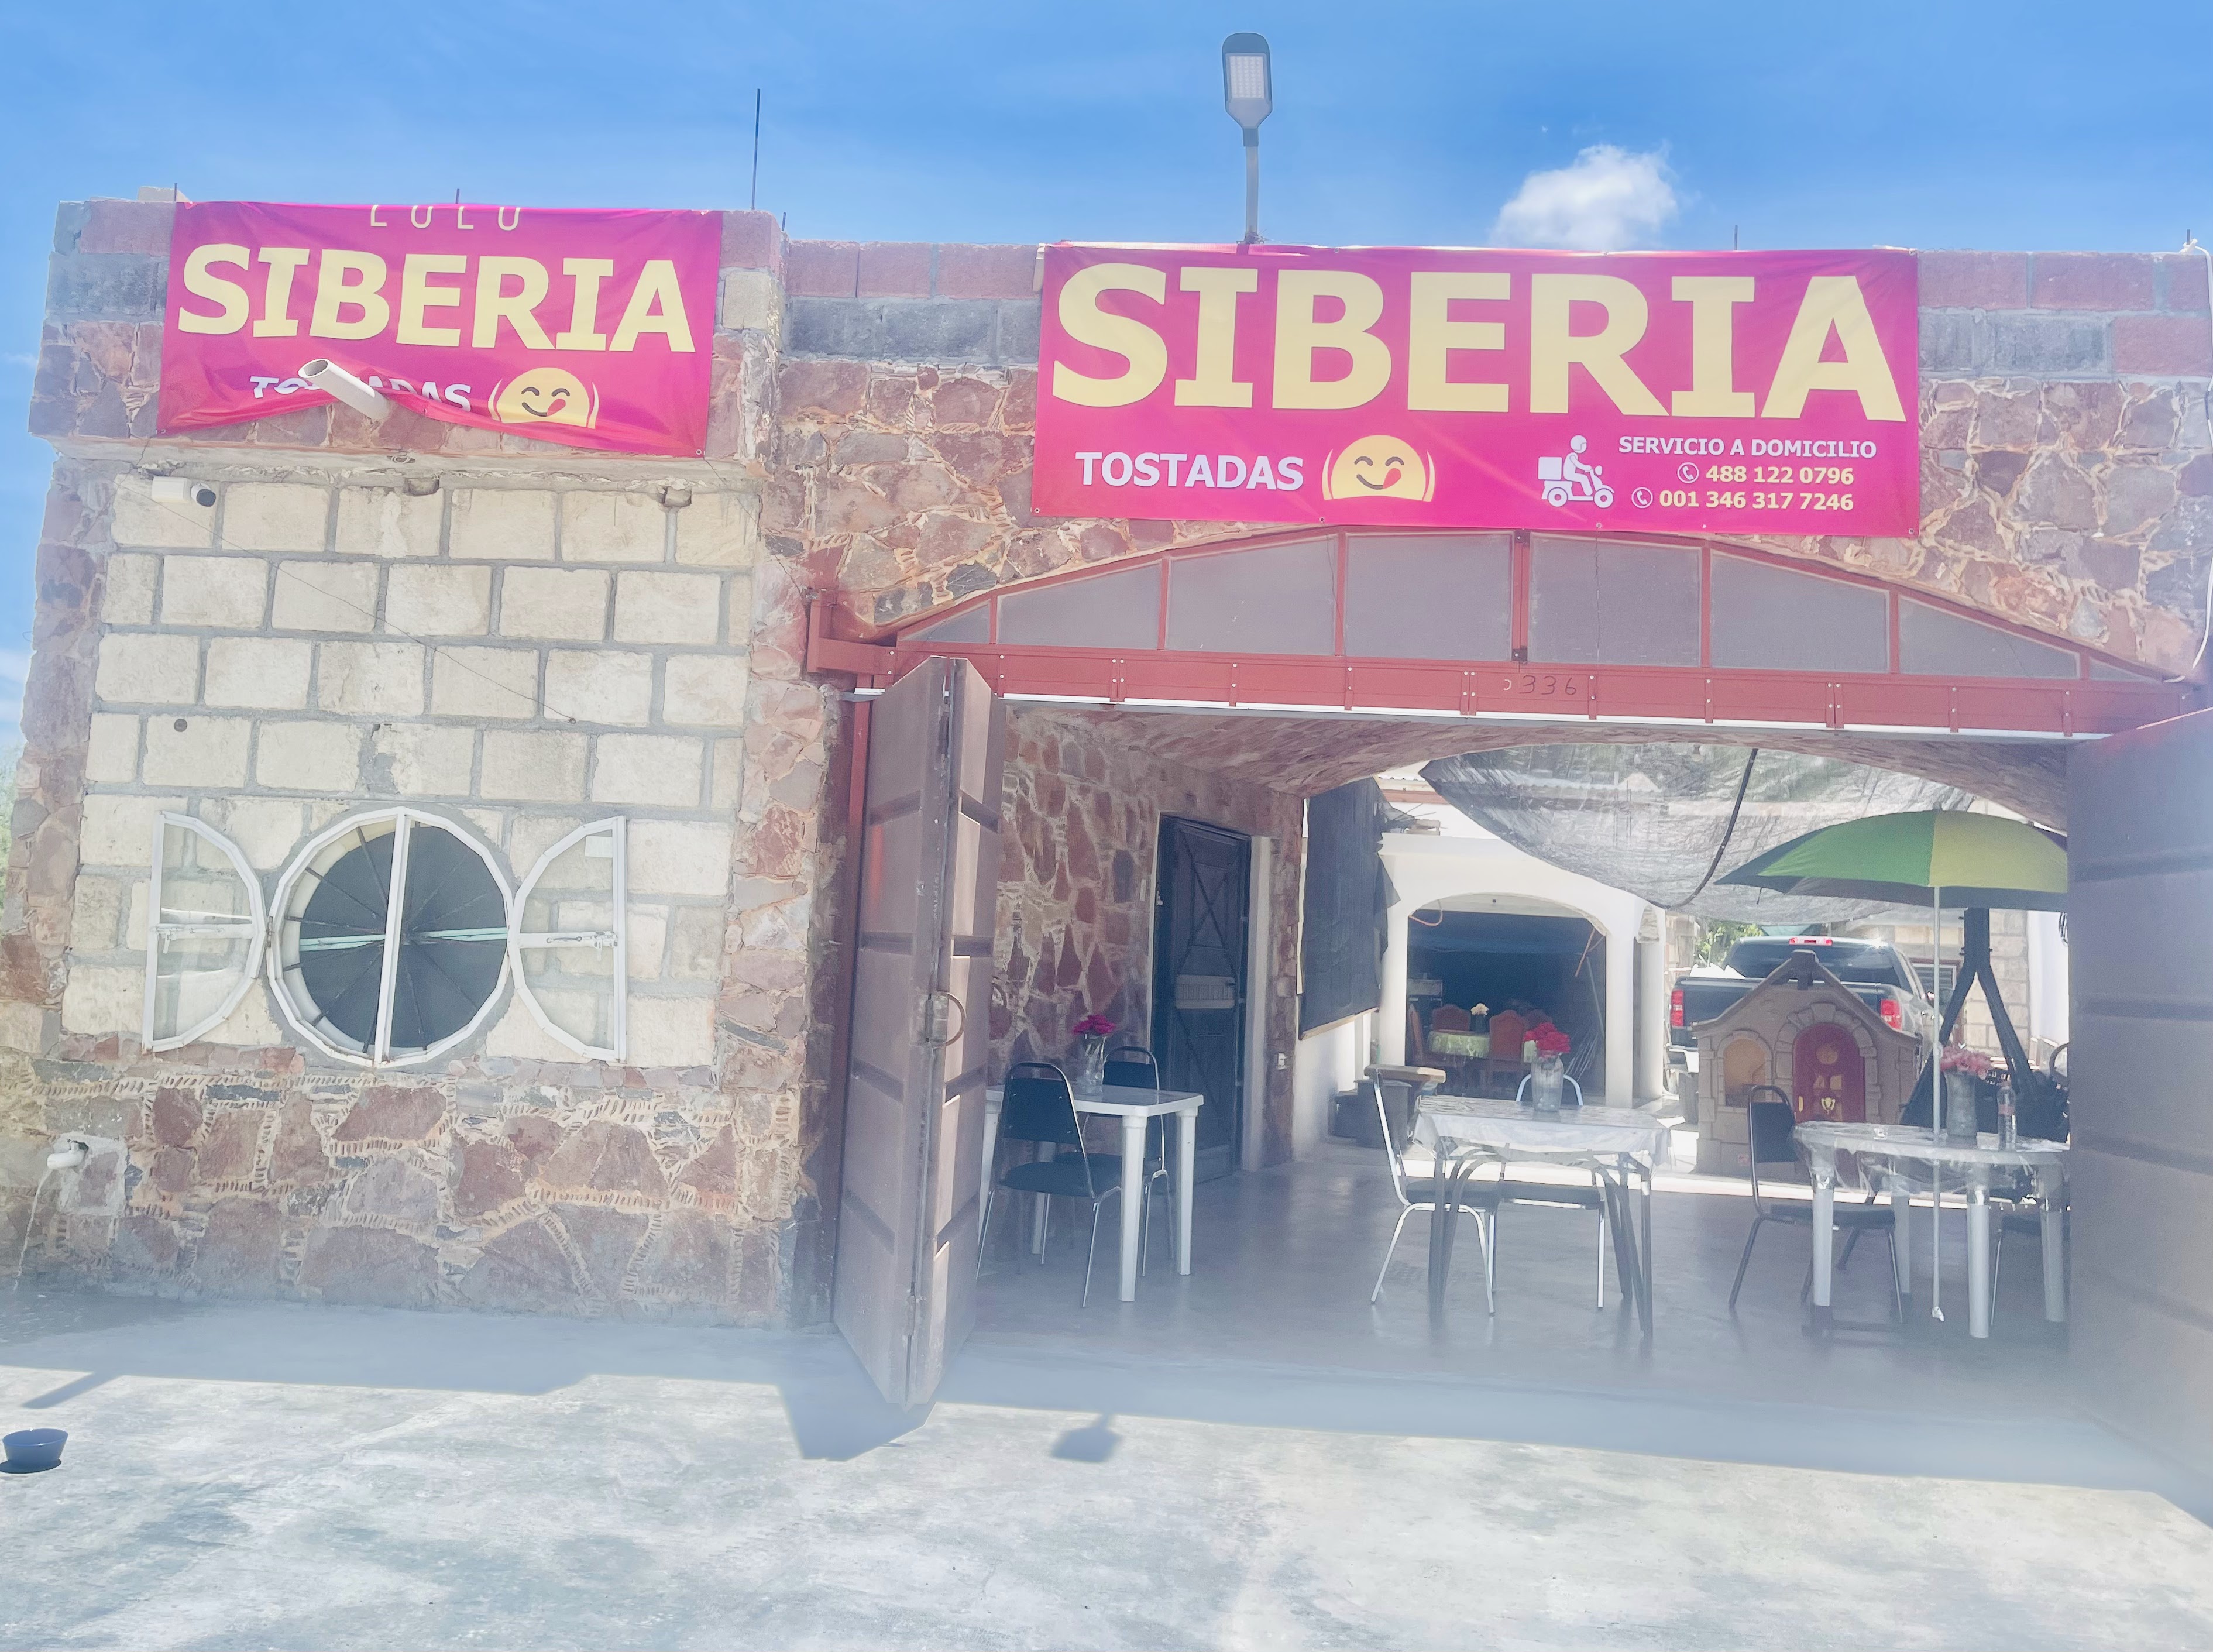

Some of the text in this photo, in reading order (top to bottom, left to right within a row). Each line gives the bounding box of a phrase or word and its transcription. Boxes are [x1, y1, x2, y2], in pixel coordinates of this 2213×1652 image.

[370, 205, 521, 231] LULU
[178, 243, 695, 353] SIBERIA
[1052, 263, 1906, 421] SIBERIA
[1618, 436, 1877, 458] SERVICIO A DOMICILIO
[1075, 452, 1303, 491] TOSTADAS
[1706, 465, 1854, 485] 488 122 0796
[1659, 490, 1854, 511] 001 346 317 7246
